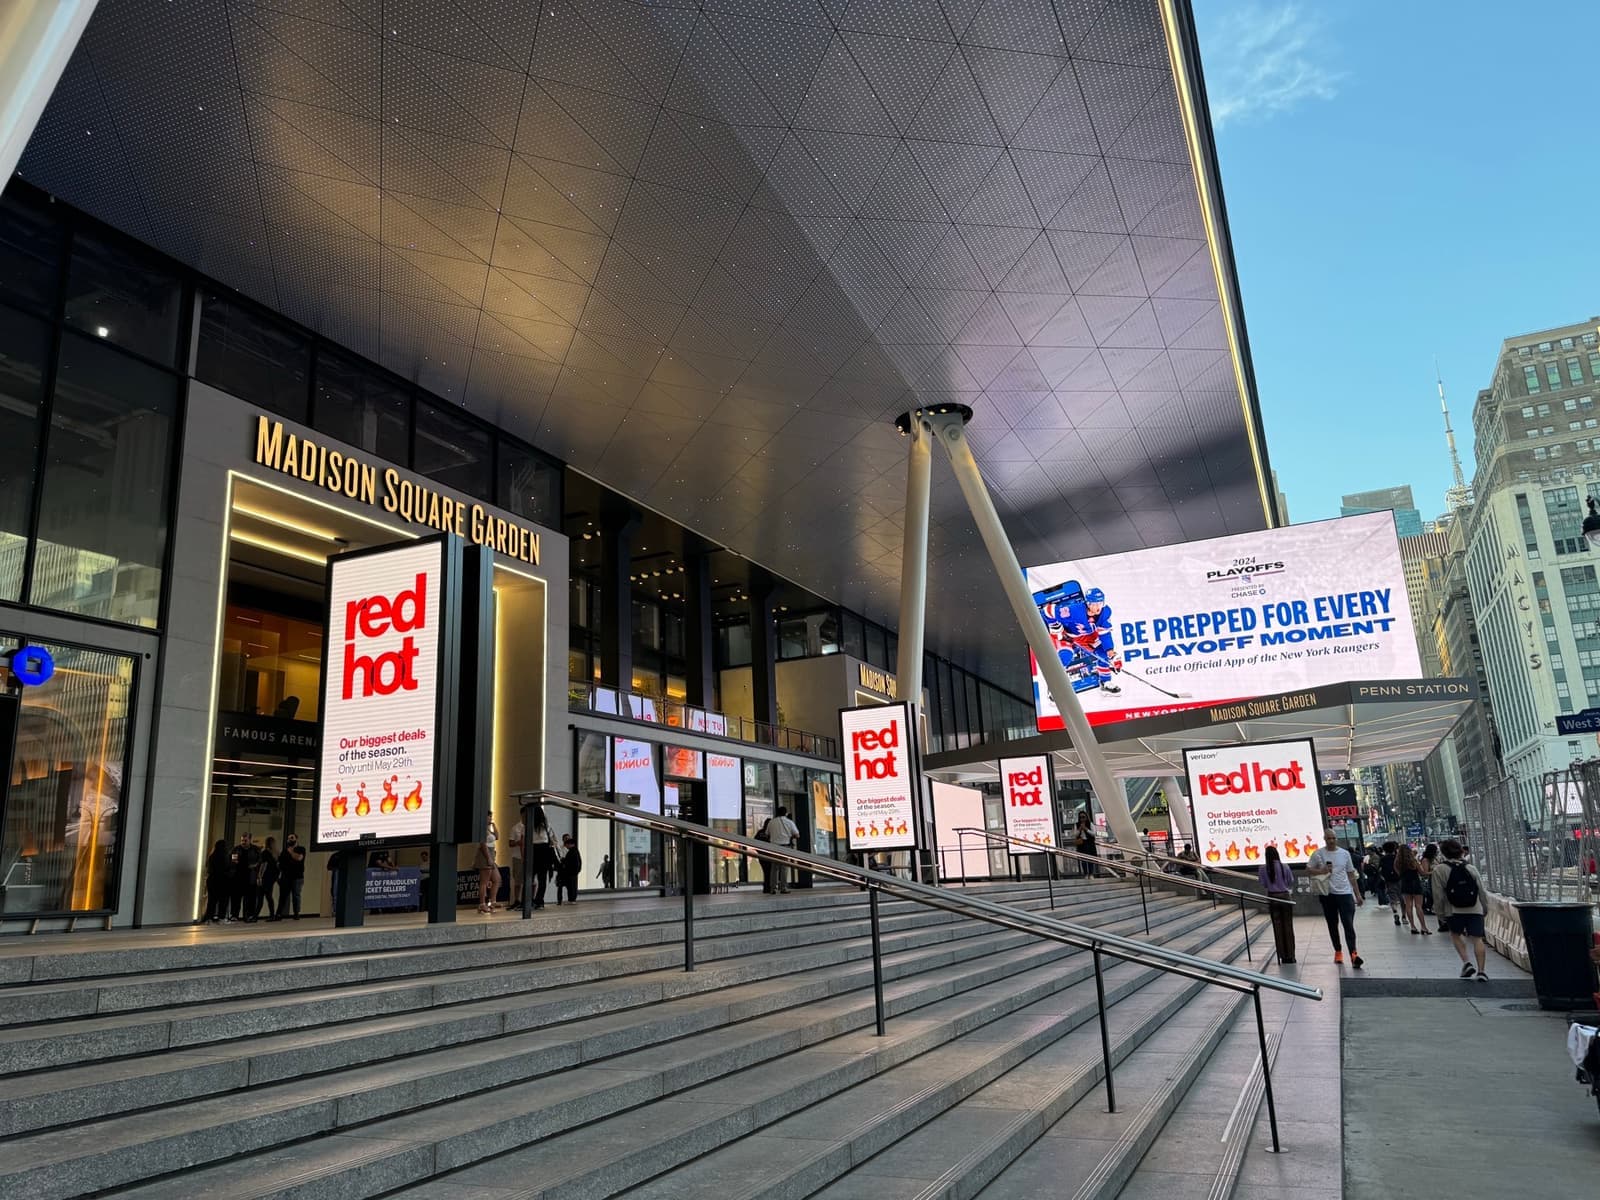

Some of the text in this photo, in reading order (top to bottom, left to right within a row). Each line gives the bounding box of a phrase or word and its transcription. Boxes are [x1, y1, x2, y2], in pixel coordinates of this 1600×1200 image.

[1207, 561, 1285, 578] PLAYOFFS
[1233, 556, 1256, 566] 2024
[1231, 590, 1258, 598] CHASE
[344, 572, 427, 641] red
[1120, 588, 1391, 646] BE PREPPED FOR EVERY
[1124, 618, 1396, 662] PLAYOFF MOMENT
[1145, 641, 1380, 675] Get the Official App of the New York Rangers
[342, 636, 419, 700] hot
[1360, 684, 1469, 696] PENN STATION
[1209, 692, 1317, 723] MADISON SQUARE GARDEN
[1562, 719, 1593, 730] West
[224, 727, 276, 742] FAMOUS
[339, 728, 426, 749] Our biggest deals
[852, 719, 898, 751] red
[339, 746, 407, 761] of the season.
[1190, 752, 1217, 760] verizon
[338, 763, 356, 774] Only
[357, 761, 374, 772] until
[374, 759, 392, 771] May
[854, 751, 898, 781] hot
[1008, 766, 1042, 787] red
[1198, 760, 1306, 796] red hot
[1010, 787, 1043, 807] hot
[1207, 808, 1278, 819] Our biggest deals
[1232, 817, 1265, 826] season.
[321, 828, 349, 839] verizon
